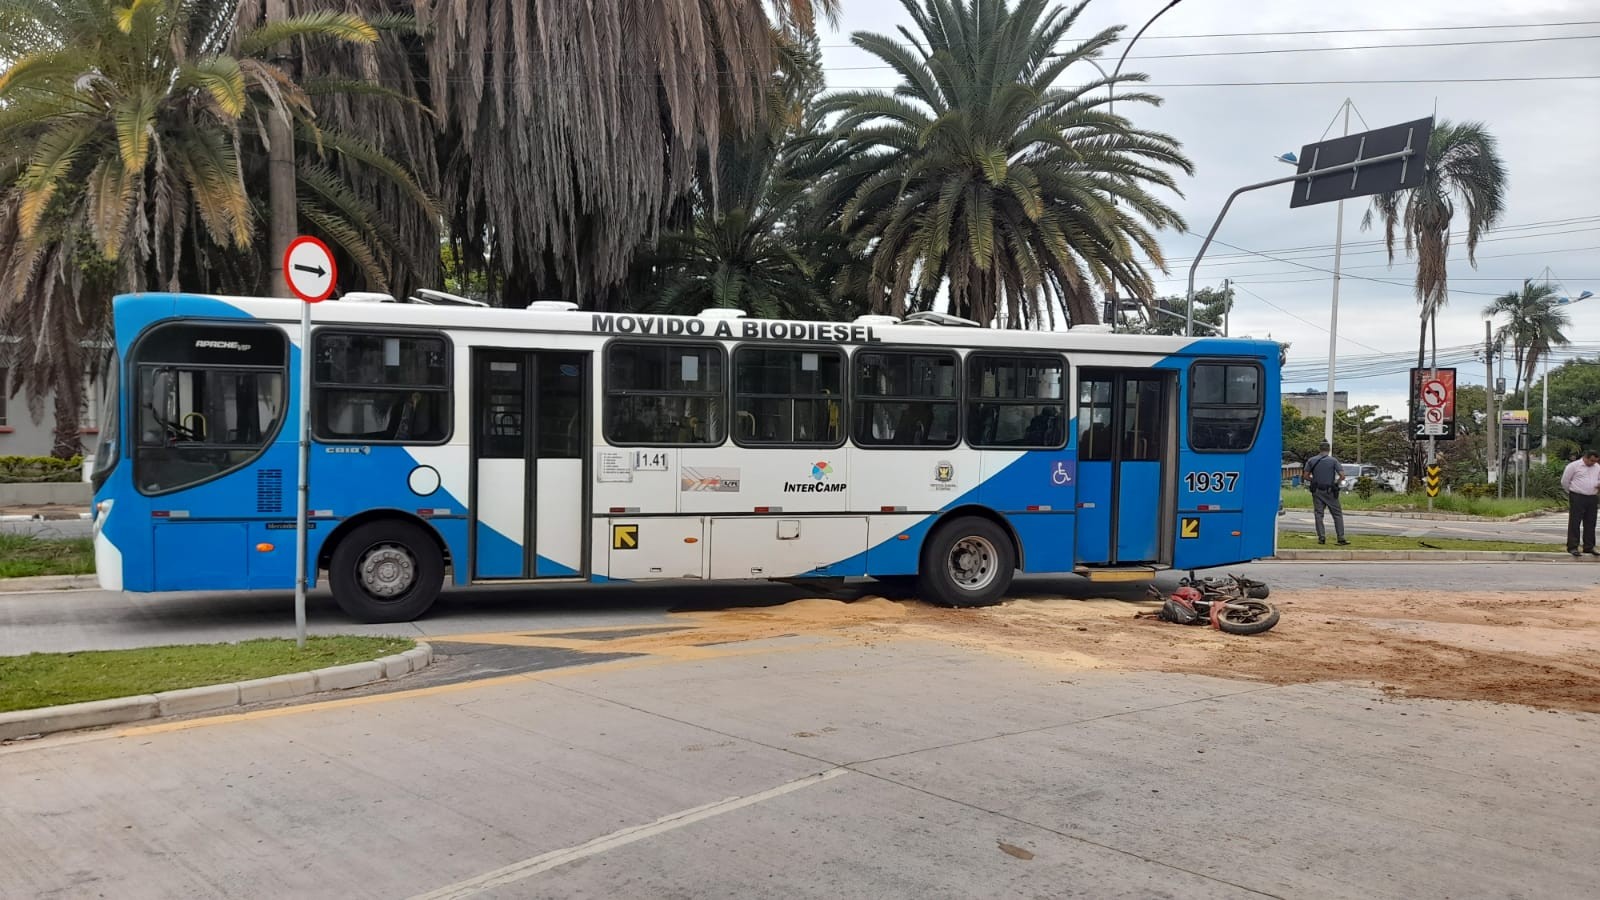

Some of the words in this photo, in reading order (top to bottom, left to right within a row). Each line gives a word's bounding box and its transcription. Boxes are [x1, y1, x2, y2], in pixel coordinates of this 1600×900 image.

[591, 314, 705, 336] MOVIDO
[715, 319, 733, 337] A
[742, 321, 881, 342] BIODIESEL
[642, 453, 666, 466] 1.41
[1184, 471, 1240, 493] 1937
